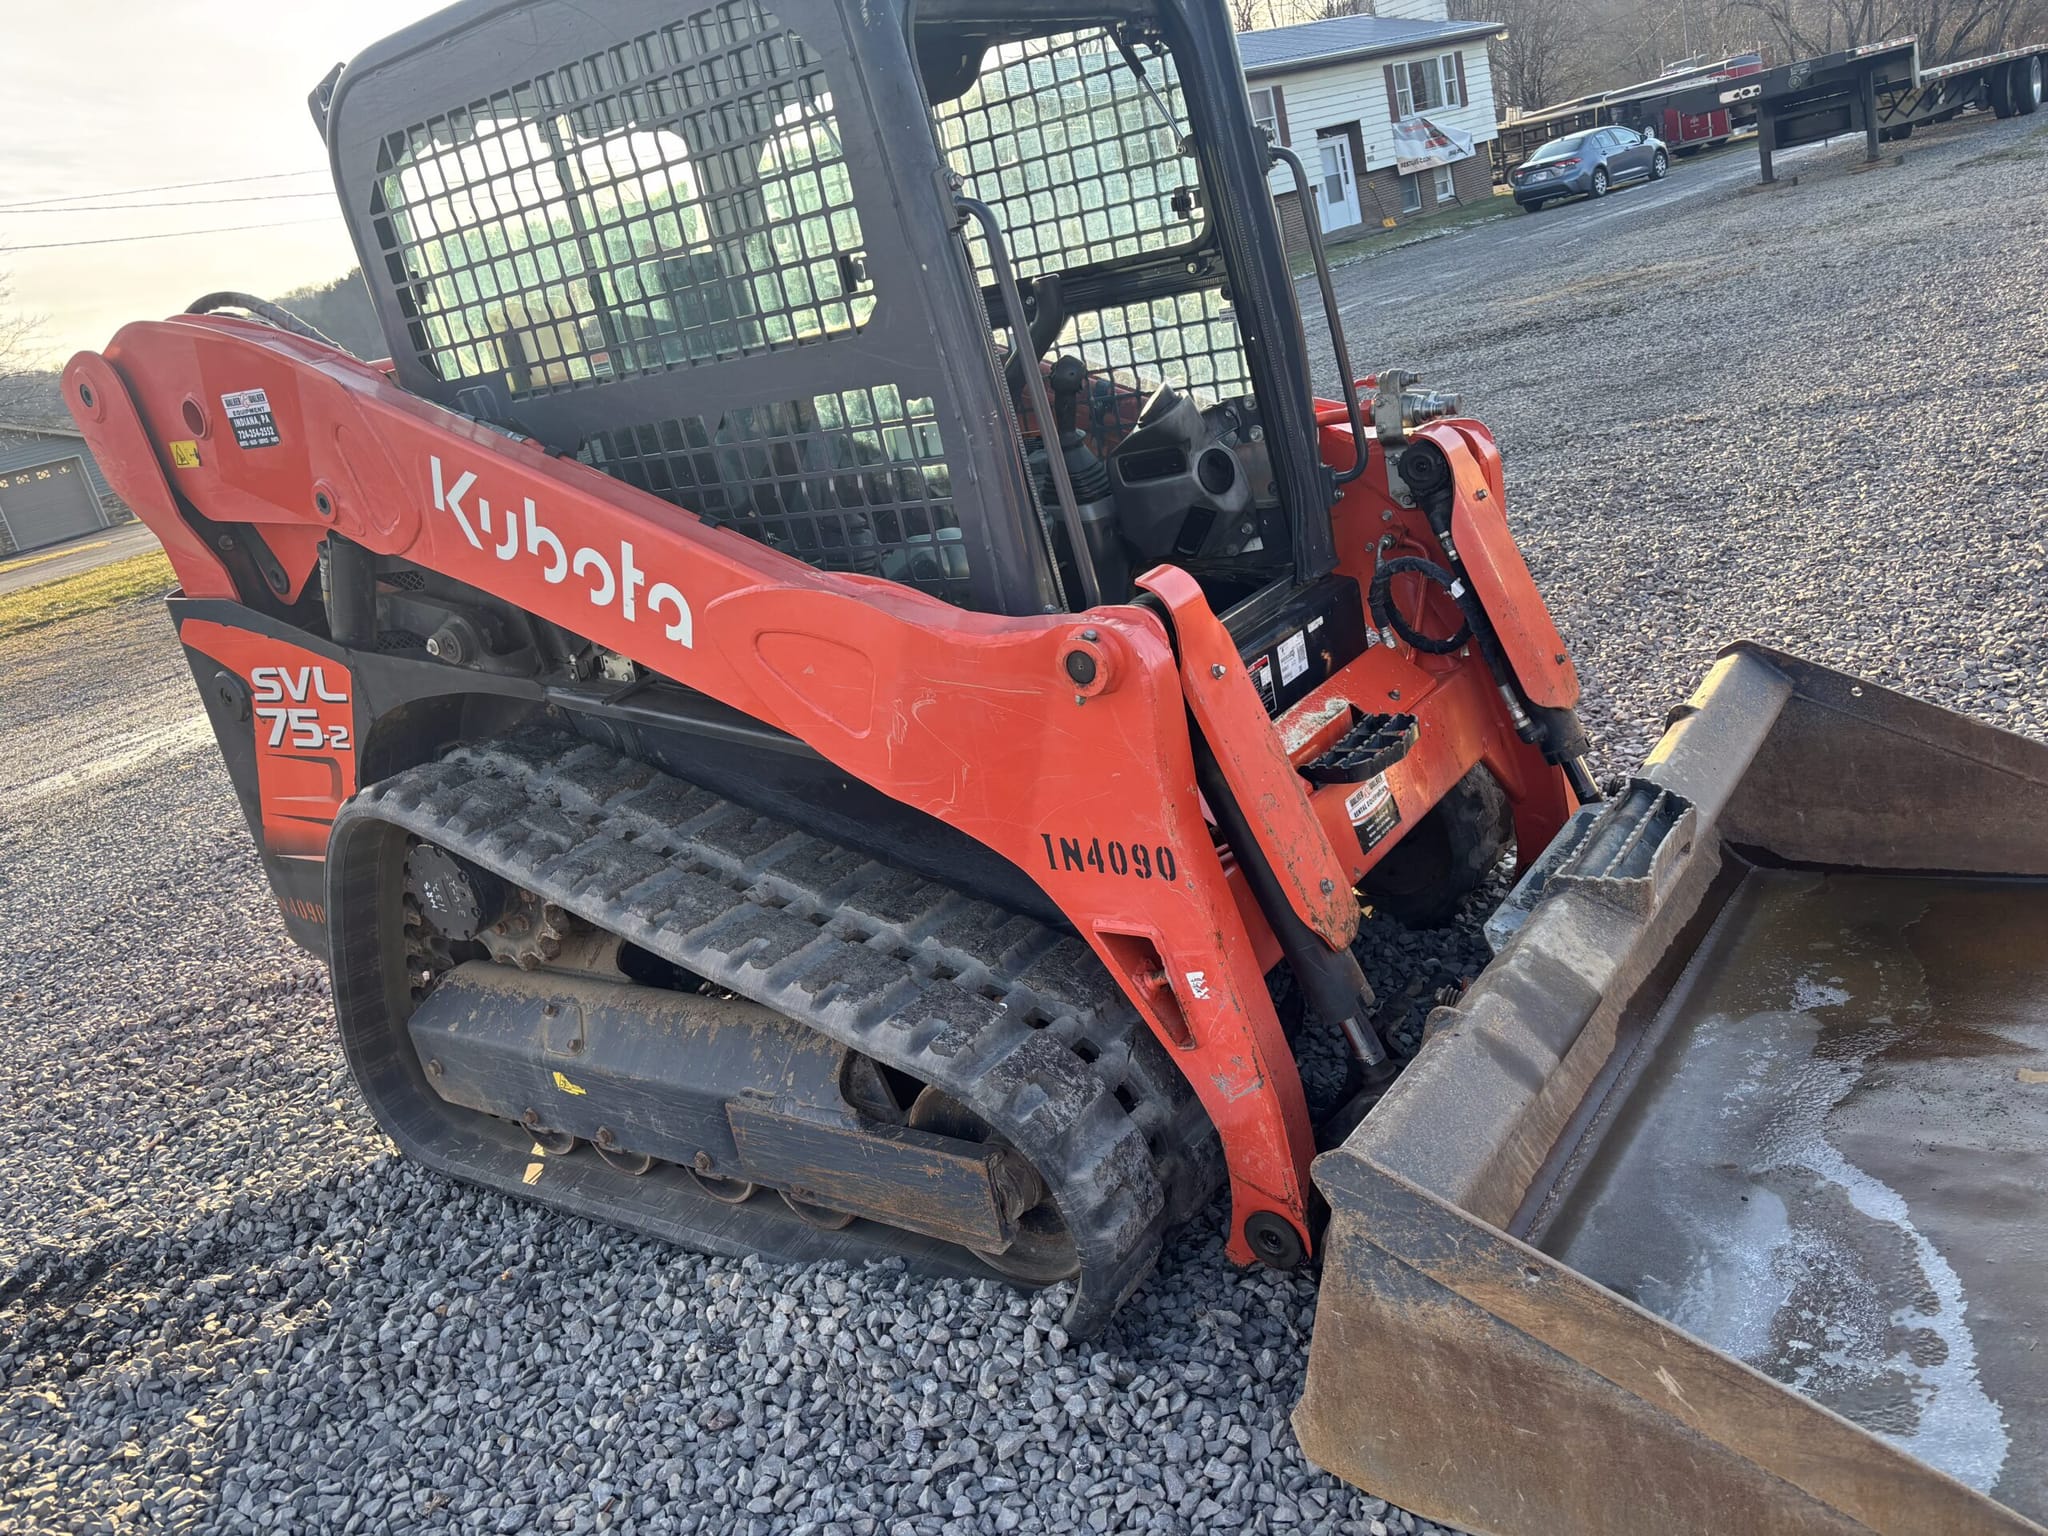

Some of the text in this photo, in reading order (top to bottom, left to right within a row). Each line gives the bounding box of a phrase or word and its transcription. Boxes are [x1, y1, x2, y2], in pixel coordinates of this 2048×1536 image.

[260, 414, 271, 424] PA
[430, 454, 693, 650] Kubota
[251, 666, 349, 703] SVL
[255, 707, 352, 750] 75-2
